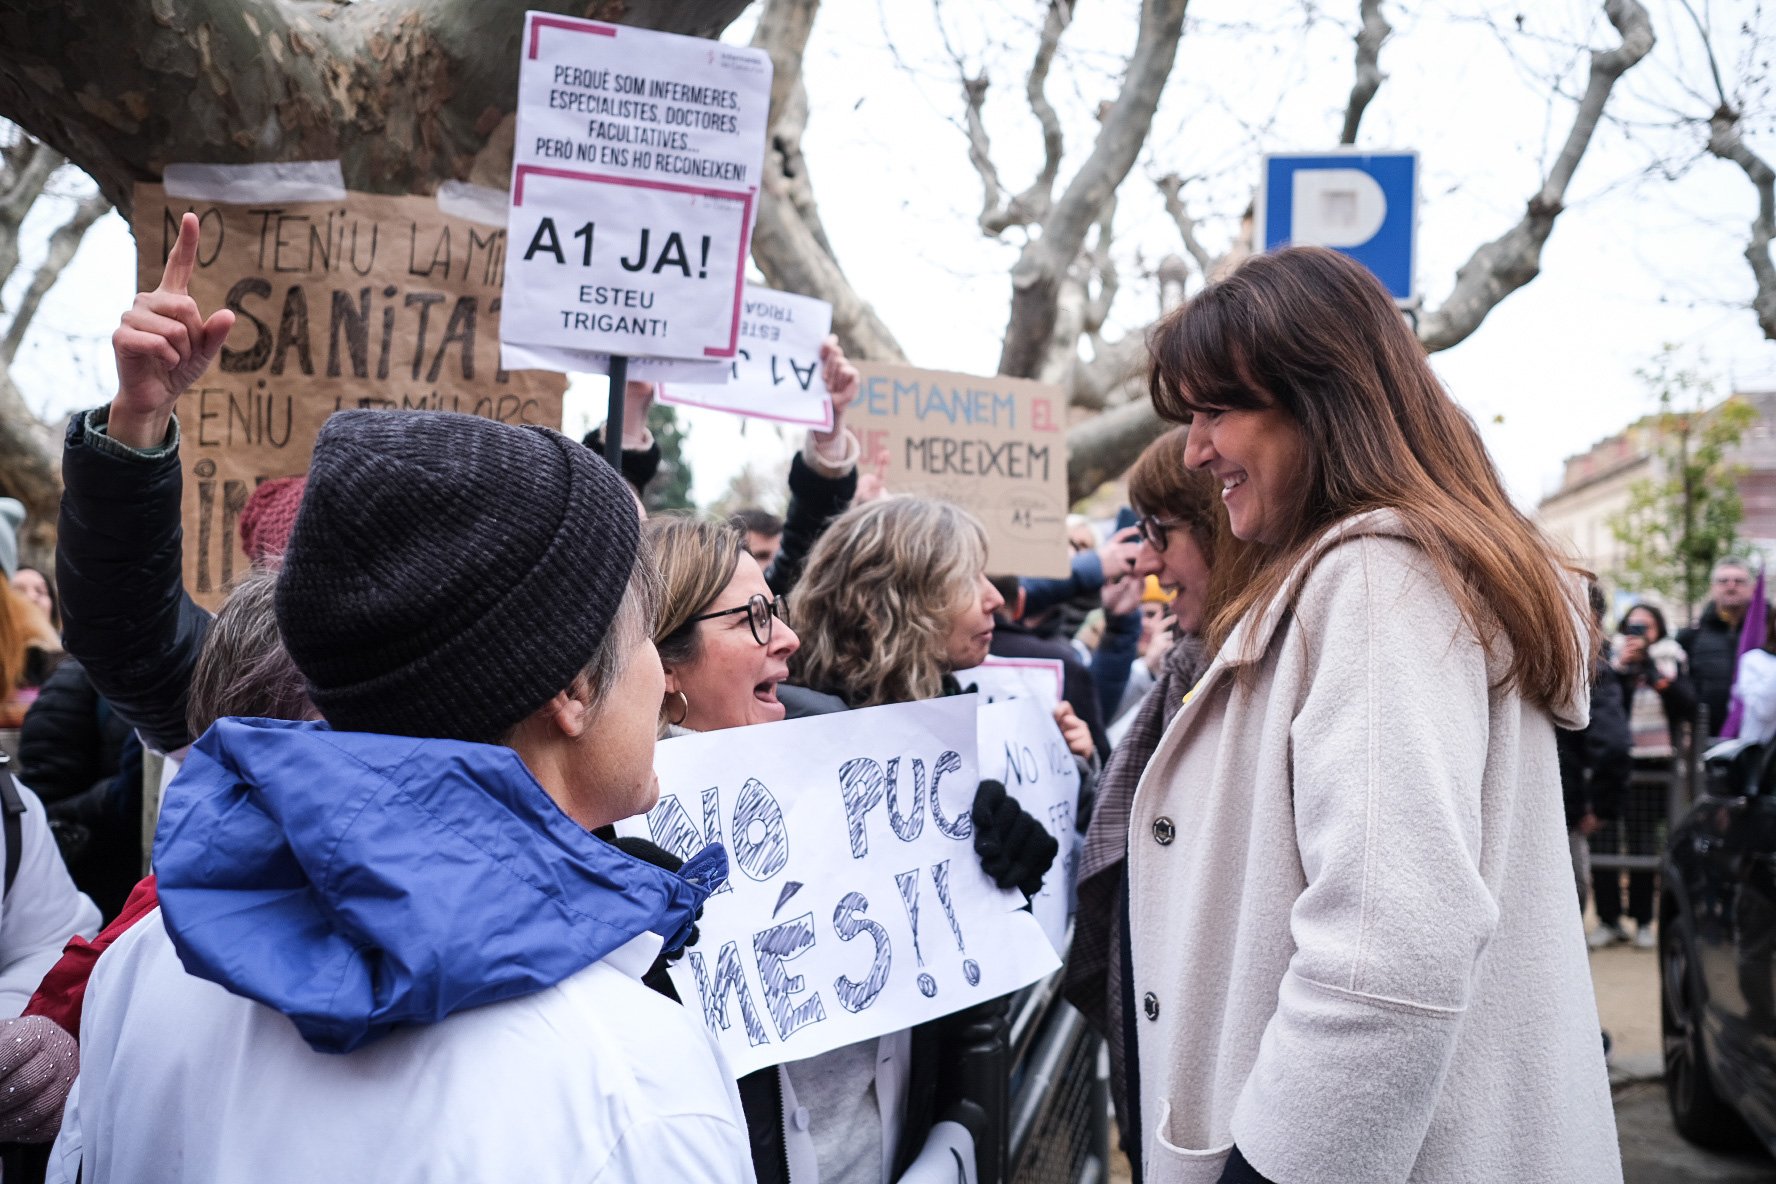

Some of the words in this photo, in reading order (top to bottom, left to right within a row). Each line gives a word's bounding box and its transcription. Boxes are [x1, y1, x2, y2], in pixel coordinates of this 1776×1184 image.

[554, 65, 610, 91] PERQUÈ
[614, 75, 646, 96] SOM
[650, 80, 741, 111] INFERMERES,
[549, 90, 661, 124] ESPECIALISTES,
[665, 107, 740, 135] DOCTORES,
[588, 121, 700, 152] FACULTATIVES...
[577, 143, 597, 162] NO
[600, 146, 628, 168] ENS
[633, 150, 651, 170] HO
[655, 154, 747, 182] RECONEIXEN!
[523, 217, 595, 267] A1
[620, 228, 711, 279] JA!
[579, 285, 655, 309] ESTEU
[745, 300, 794, 323] TRIGA
[560, 310, 669, 337] TRIGANT!
[741, 321, 780, 341] ESTE
[1004, 740, 1038, 786] NO
[838, 750, 974, 860] PUC
